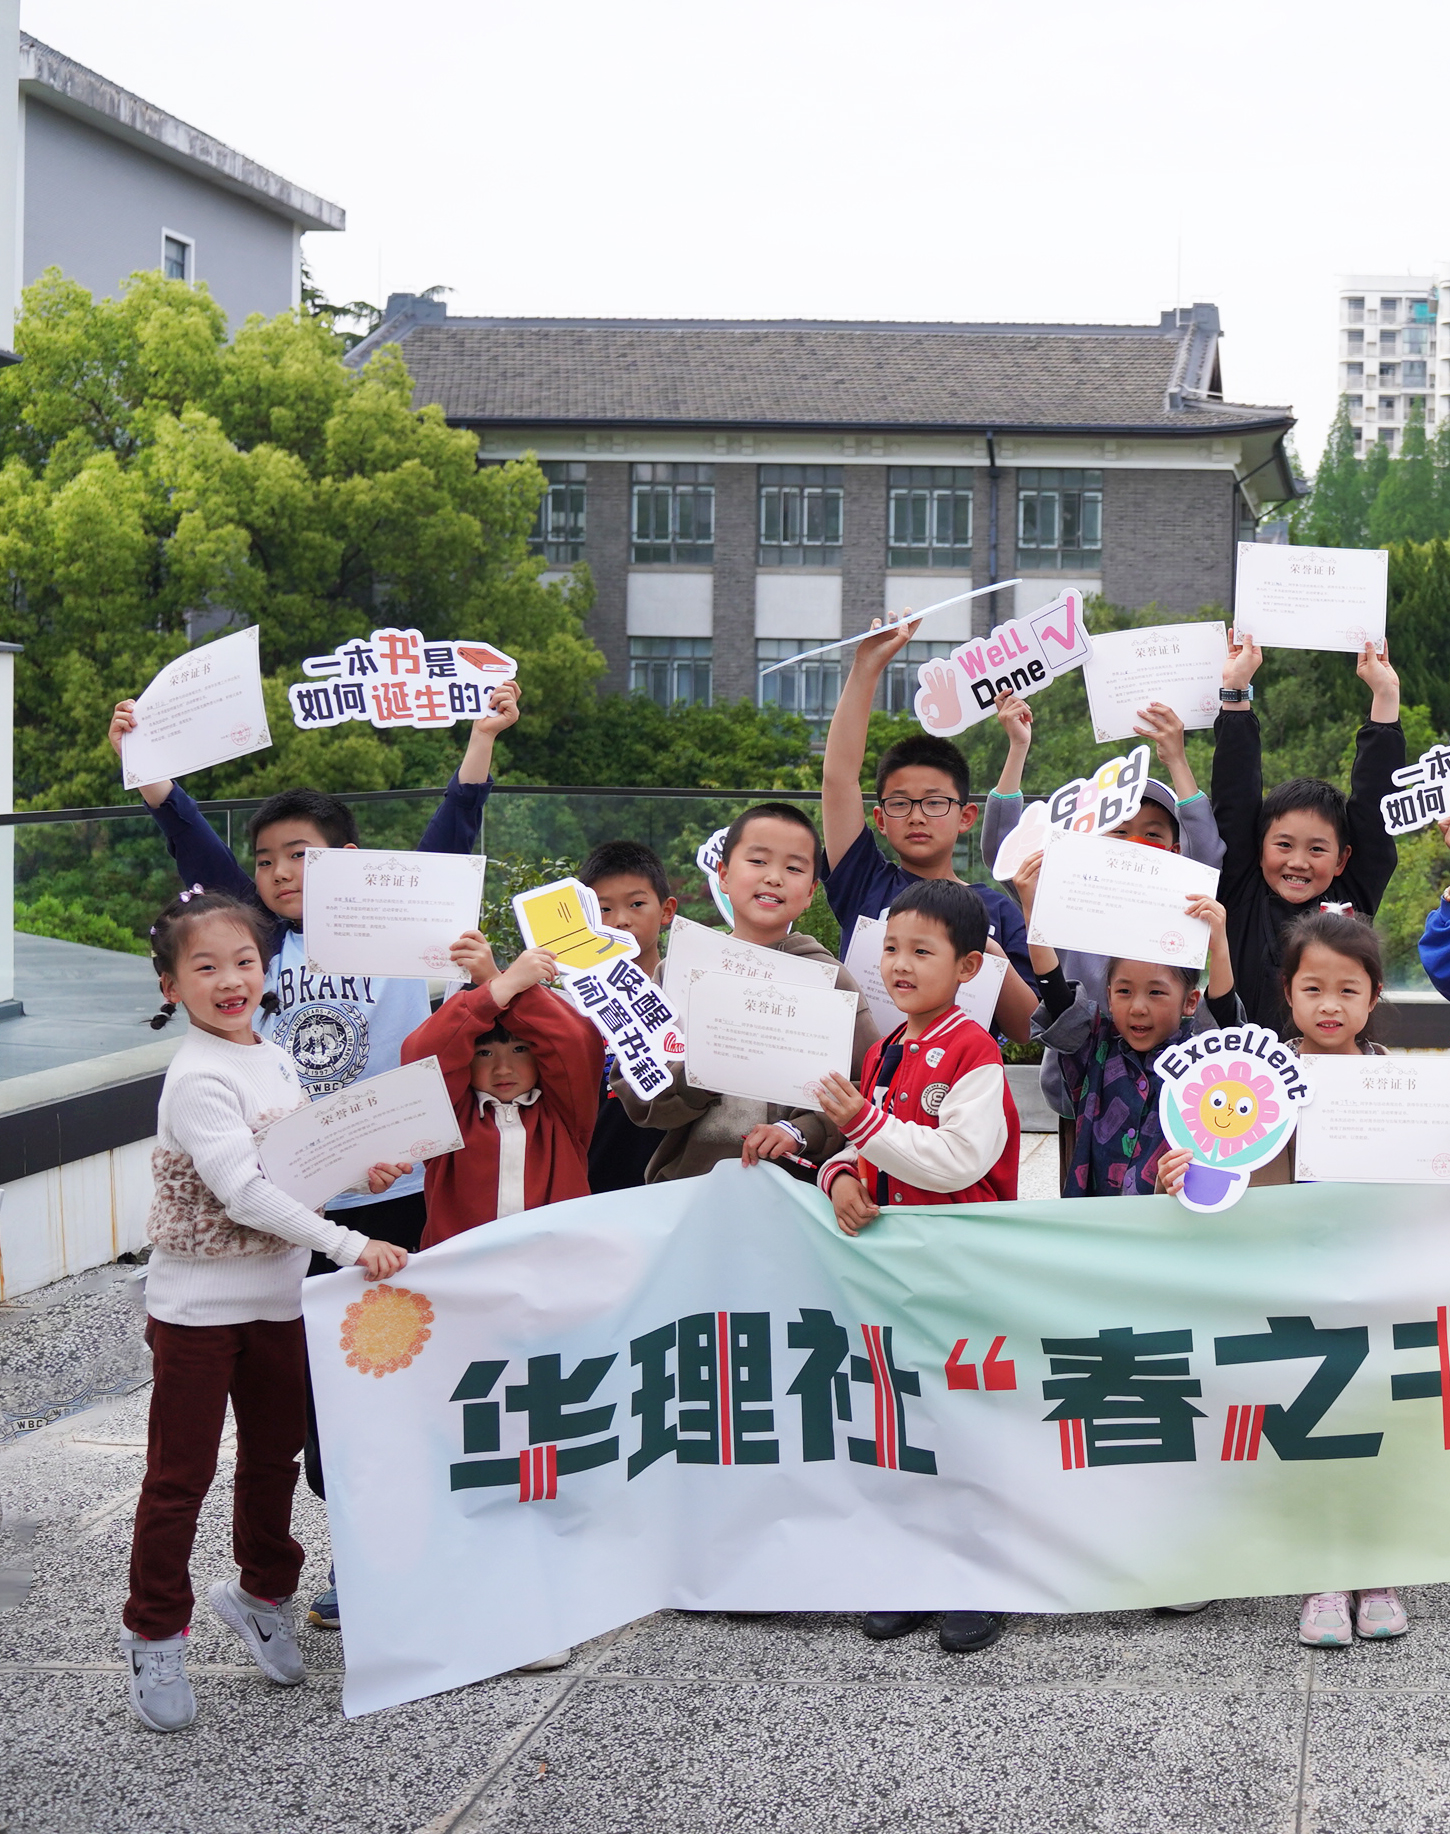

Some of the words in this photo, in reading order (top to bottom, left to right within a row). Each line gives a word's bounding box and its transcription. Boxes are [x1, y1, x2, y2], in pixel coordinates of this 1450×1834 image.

[310, 634, 458, 679] 一本书是
[957, 627, 1029, 680] Well
[1135, 643, 1181, 658] 荣誉证书
[169, 663, 212, 687] 荣誉证书
[970, 659, 1046, 710] Done
[1051, 751, 1143, 823] Good
[364, 873, 420, 888] 荣誉证书
[1106, 857, 1161, 876] 荣誉证书
[279, 966, 376, 1010] BRARY
[607, 959, 673, 1034] 唤醒
[744, 998, 798, 1018] 荣誉证书
[572, 975, 666, 1093] 闲置书籍
[1161, 1030, 1308, 1100] Excellent
[1362, 1077, 1417, 1091] 荣誉证书
[320, 1096, 379, 1127] 荣誉证书
